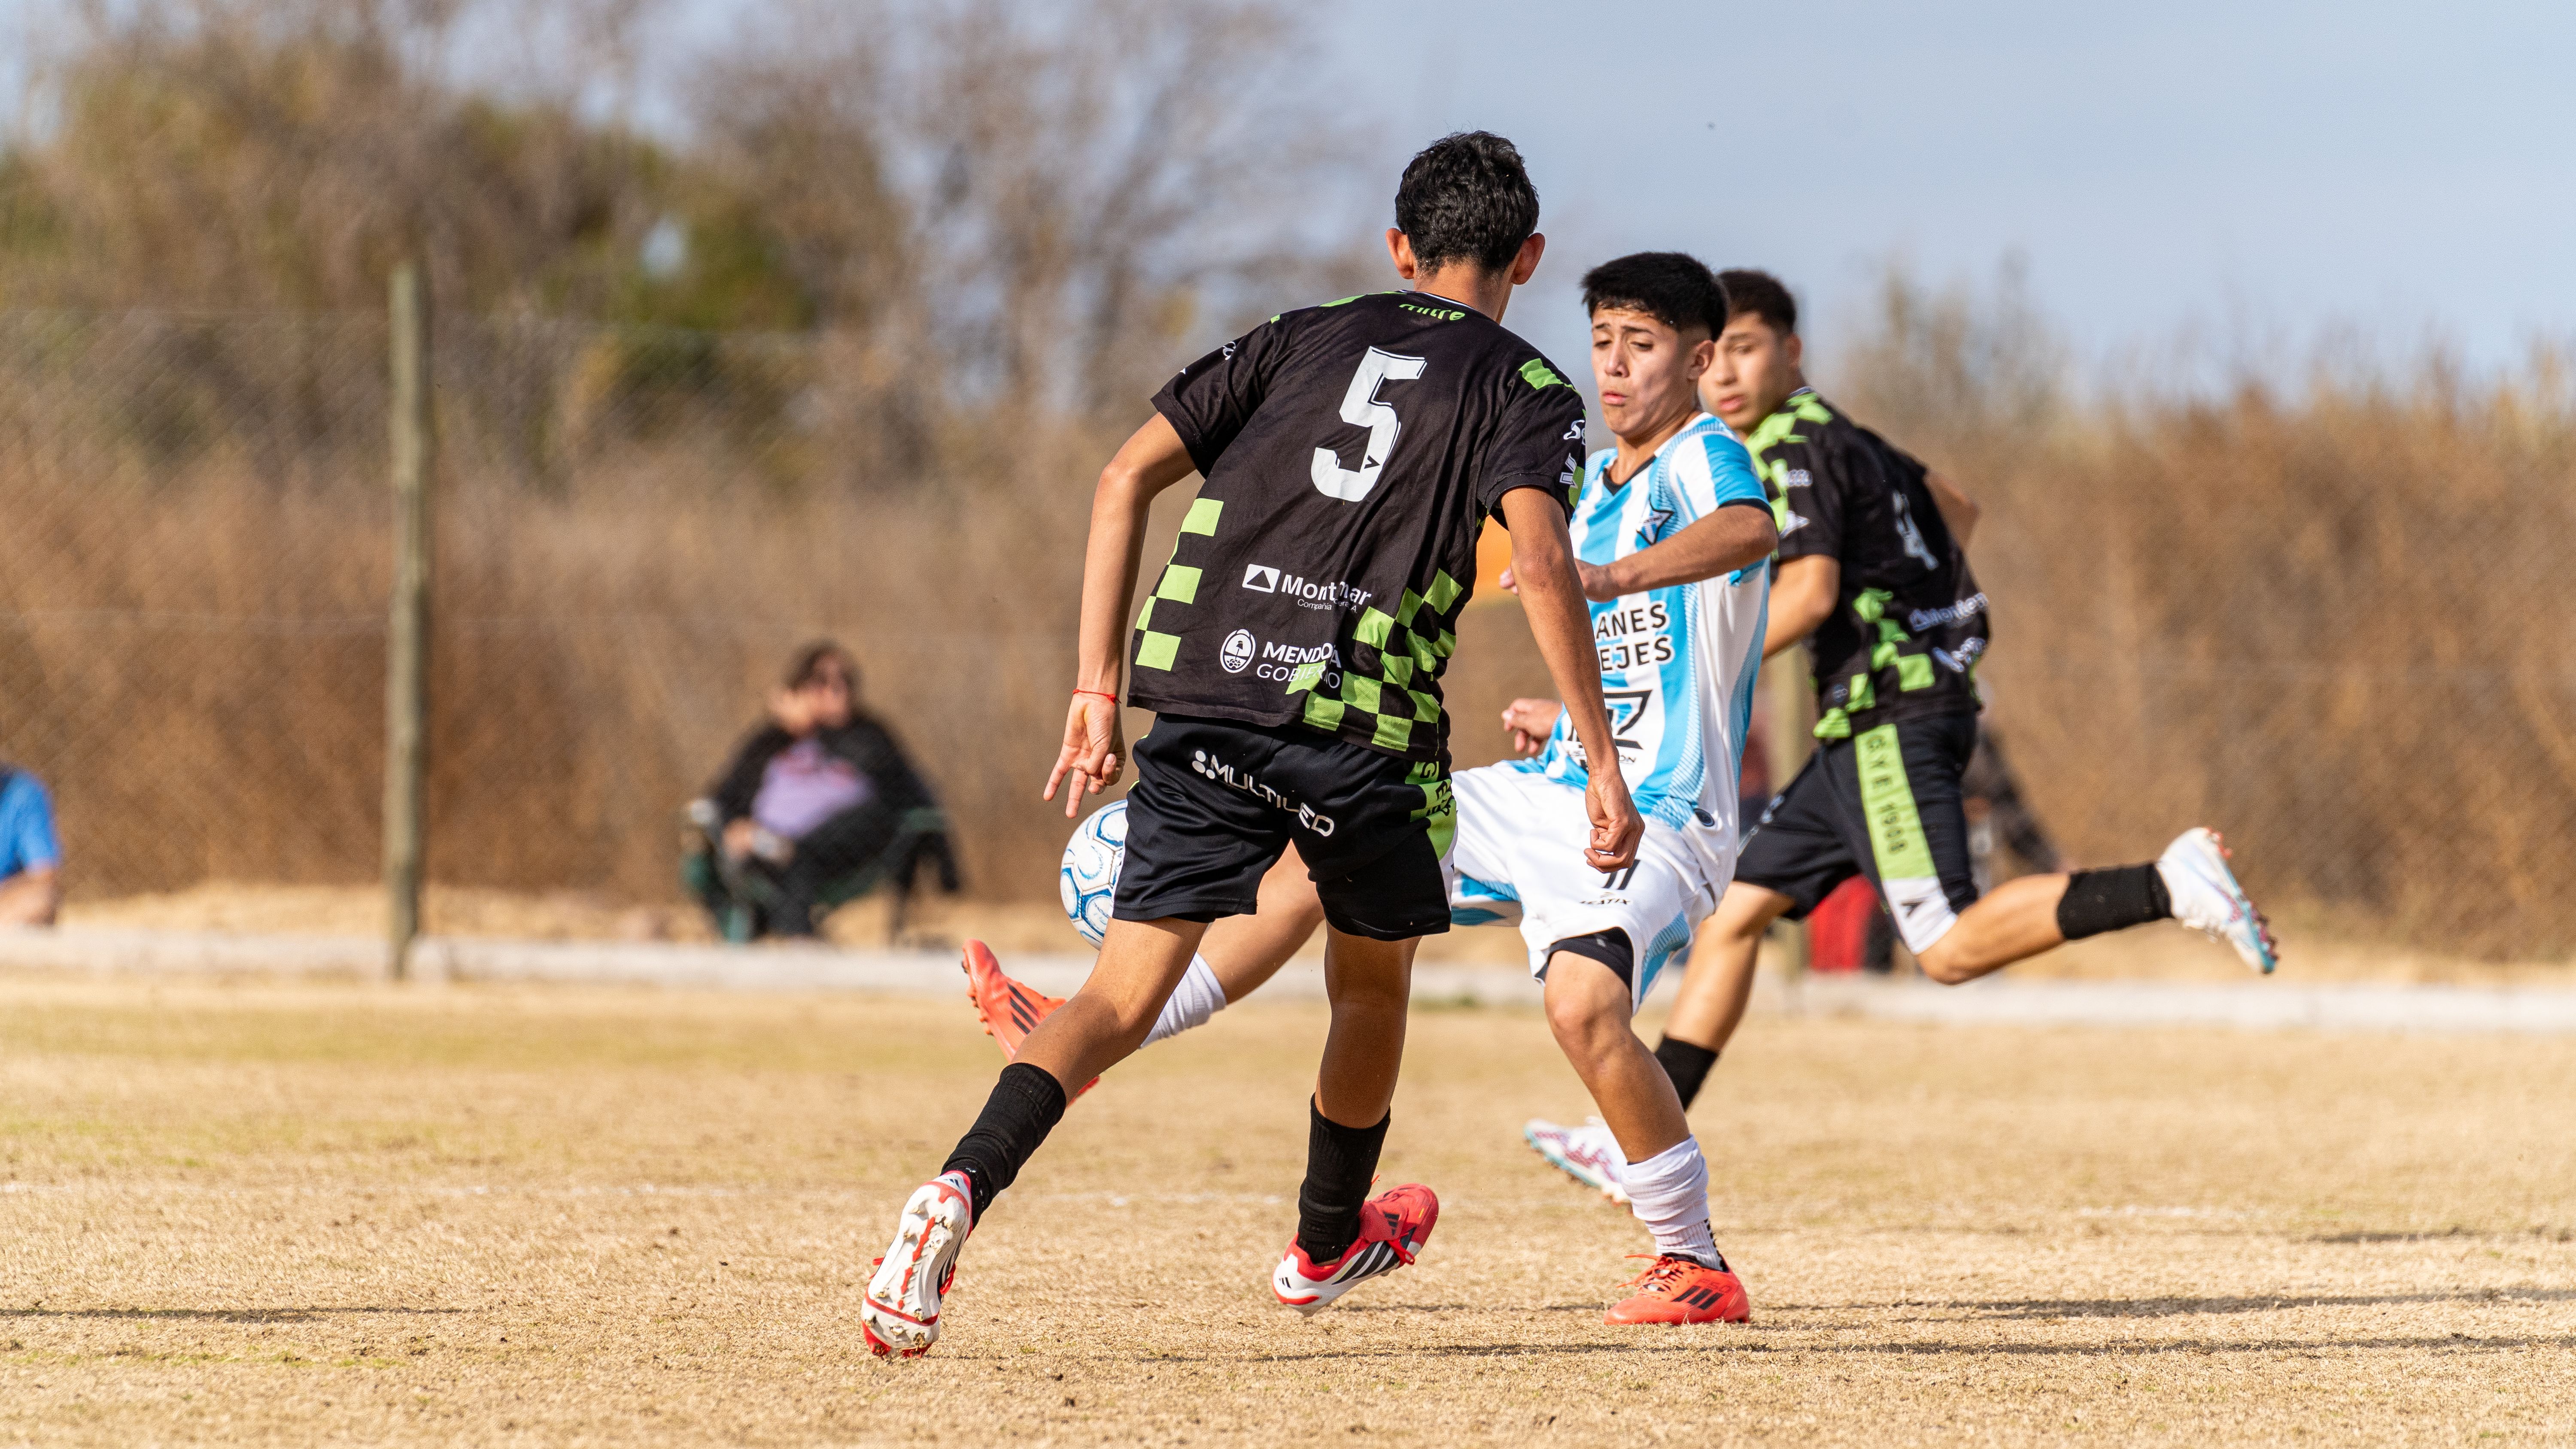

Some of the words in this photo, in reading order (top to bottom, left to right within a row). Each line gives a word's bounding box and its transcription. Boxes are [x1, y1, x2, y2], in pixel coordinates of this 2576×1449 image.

[1311, 346, 1427, 502] 5
[1281, 574, 1372, 605] Montmar
[1596, 604, 1666, 639] ANES
[1262, 642, 1341, 668] MENDOA
[1600, 637, 1671, 671] EJES
[1211, 755, 1334, 837] MULTILED
